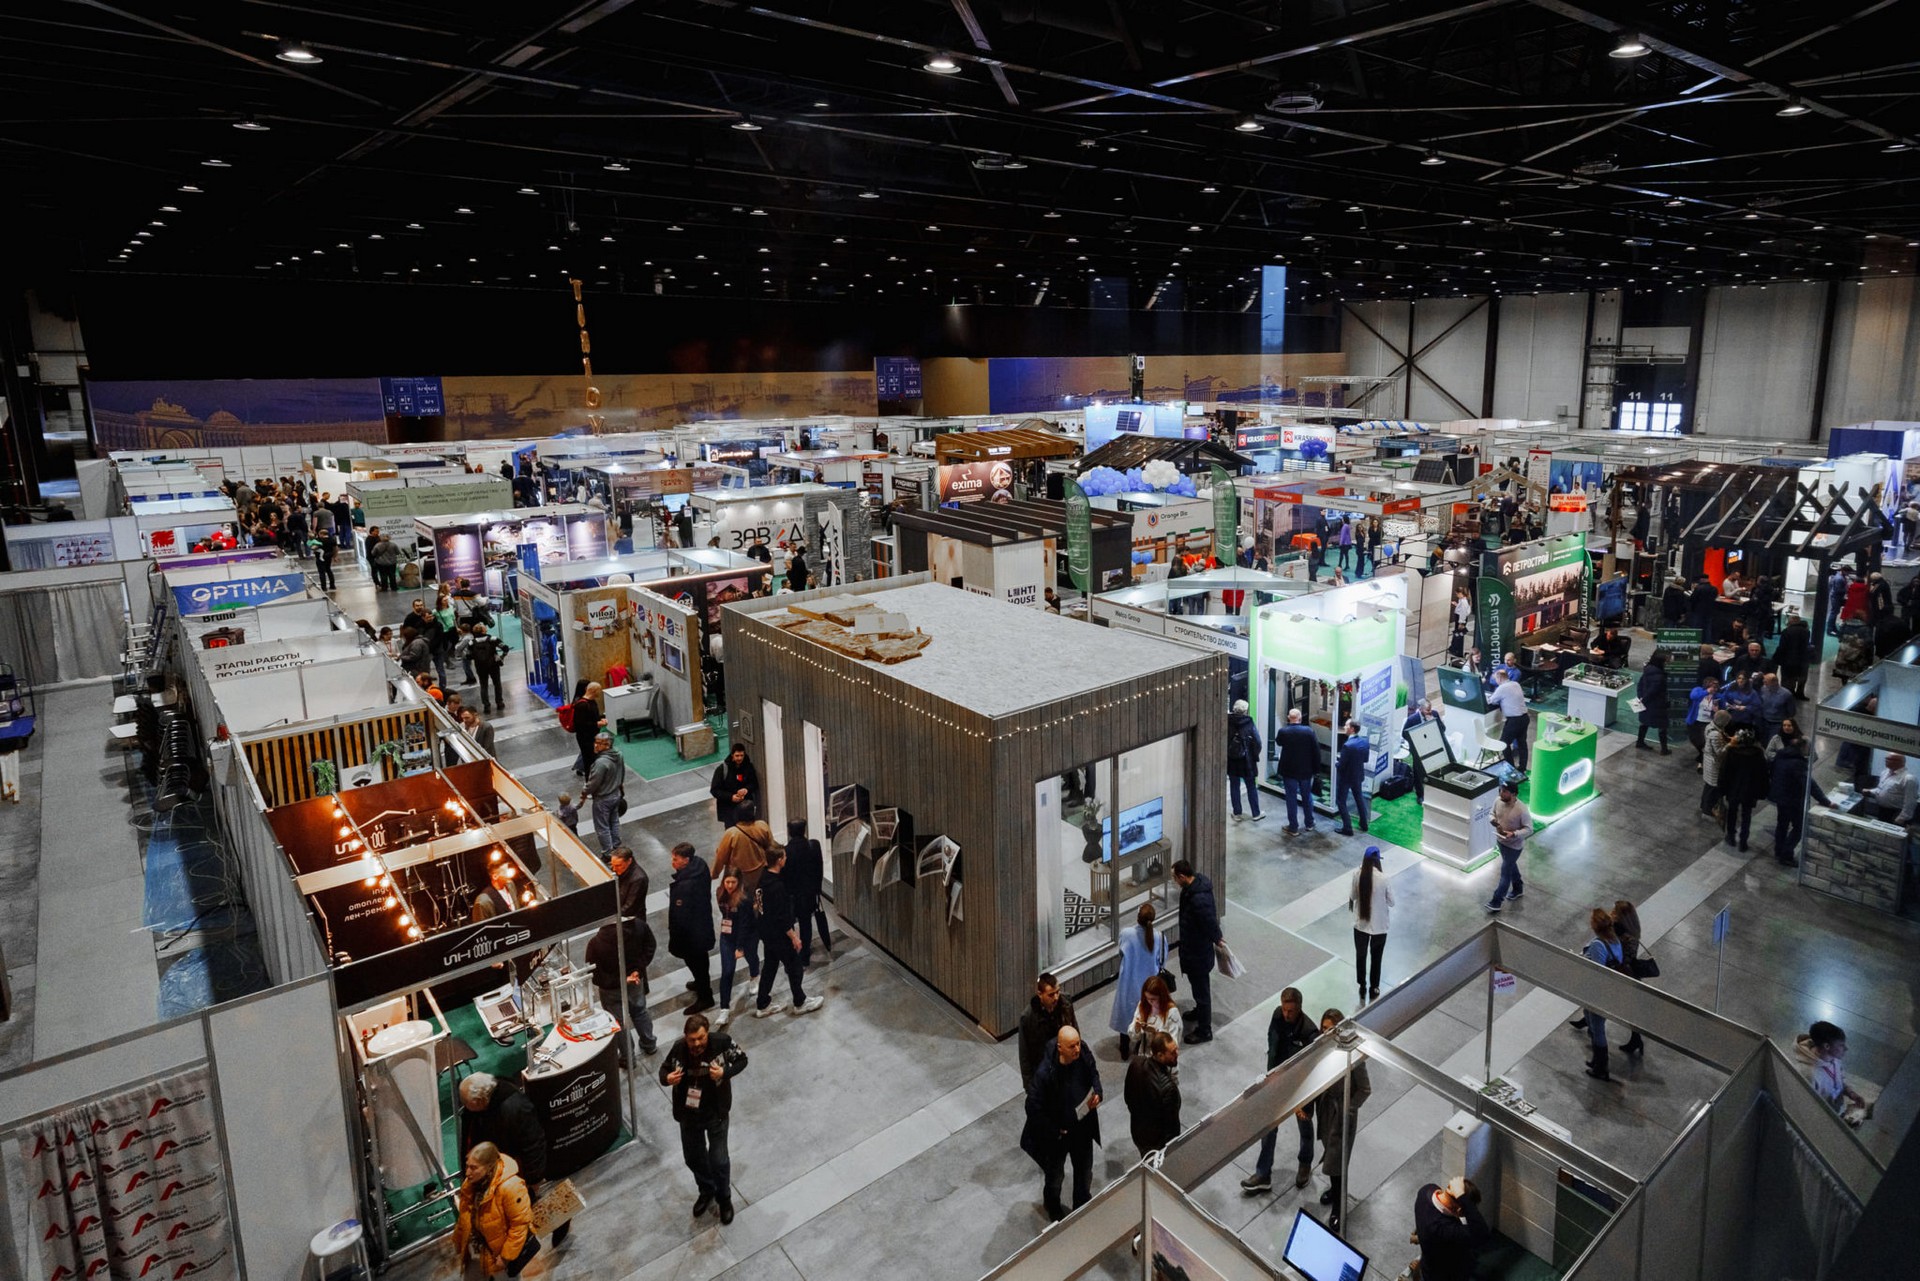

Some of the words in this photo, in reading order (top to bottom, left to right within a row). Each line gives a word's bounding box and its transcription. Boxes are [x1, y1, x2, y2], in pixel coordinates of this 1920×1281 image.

[952, 478, 982, 490] exima
[1513, 552, 1550, 572] ПЕТРОСТРОЙ
[192, 579, 290, 602] OPTIMA
[202, 612, 236, 622] Bruno
[1174, 626, 1217, 644] СТРОИТЕЛЬСТВО
[1218, 638, 1237, 650] ДОМОВ
[1490, 610, 1500, 668] ПЕТРОСТРО
[215, 660, 254, 670] ЭТАПЫ
[256, 652, 300, 664] РАБОТЫ
[1824, 718, 1916, 746] Крупноформатный
[344, 905, 388, 922] лен-ремо
